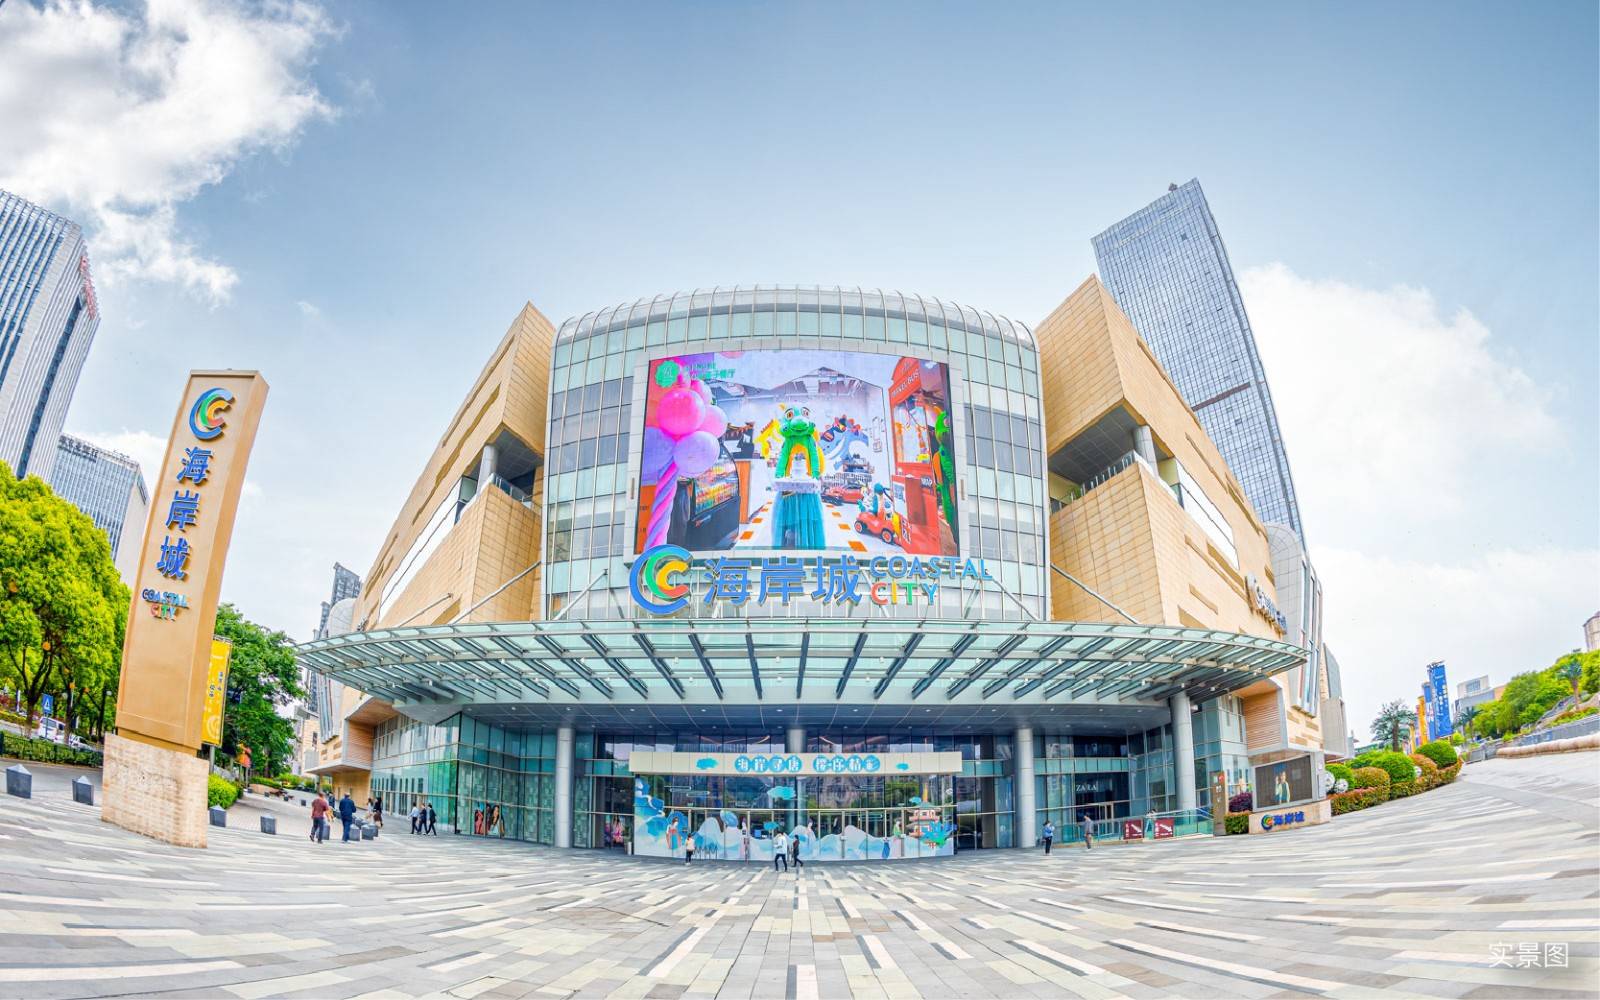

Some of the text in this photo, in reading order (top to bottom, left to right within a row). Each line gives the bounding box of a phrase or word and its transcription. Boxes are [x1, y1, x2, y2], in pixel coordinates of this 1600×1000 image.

[156, 446, 213, 580] 海岸城
[870, 555, 993, 580] COASTAL
[704, 556, 863, 606] 海岸城
[871, 581, 938, 606] CITY
[142, 588, 188, 607] COASTAL
[151, 603, 176, 619] CITY
[1075, 783, 1097, 792] ZARA
